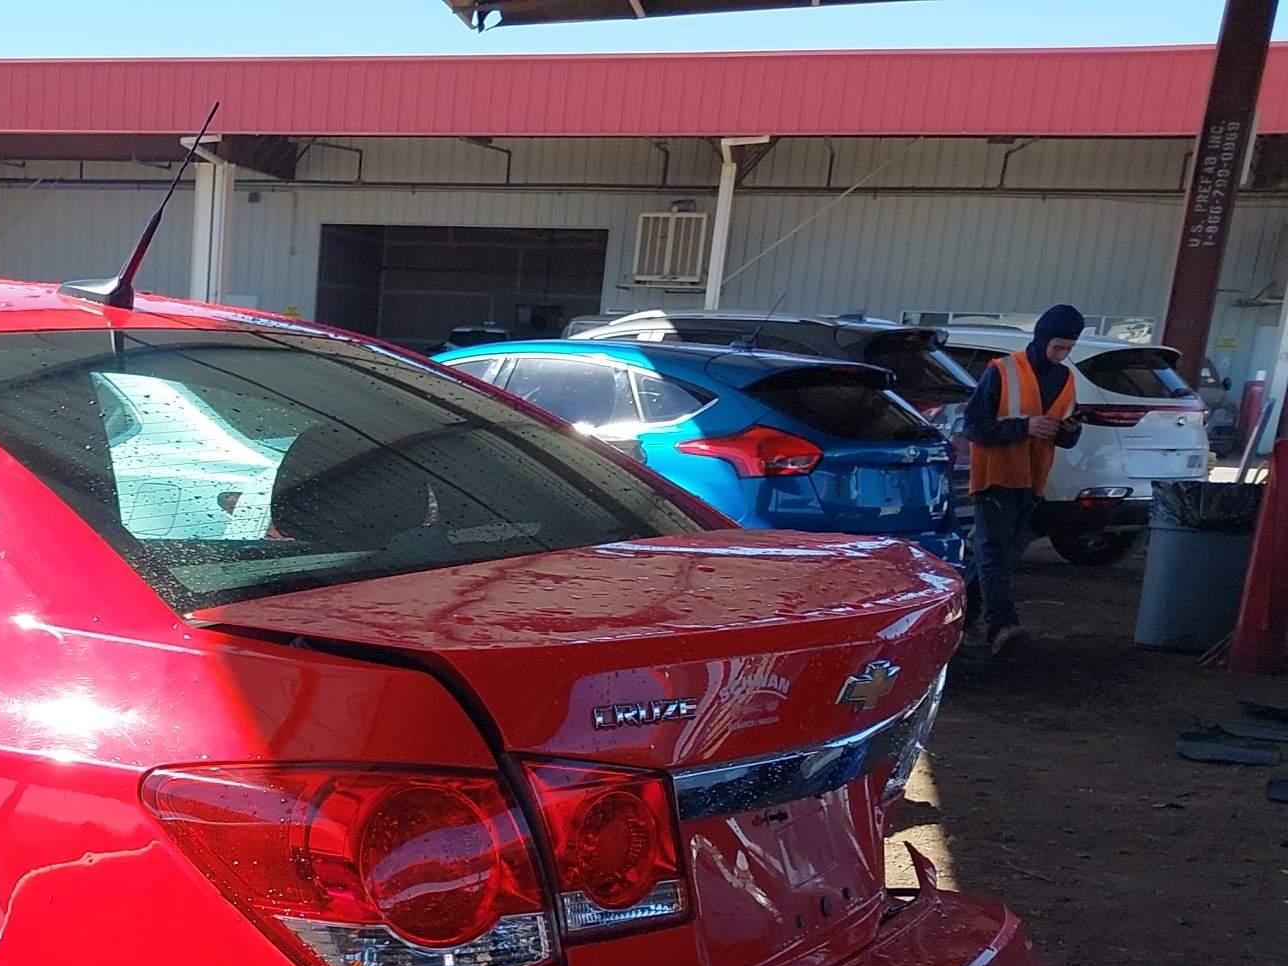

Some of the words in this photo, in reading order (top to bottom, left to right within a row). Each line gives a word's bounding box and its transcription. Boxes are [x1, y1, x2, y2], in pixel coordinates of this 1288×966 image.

[1194, 156, 1218, 212] PREFAB
[1207, 120, 1225, 149] INC.
[593, 698, 697, 729] CRUZE
